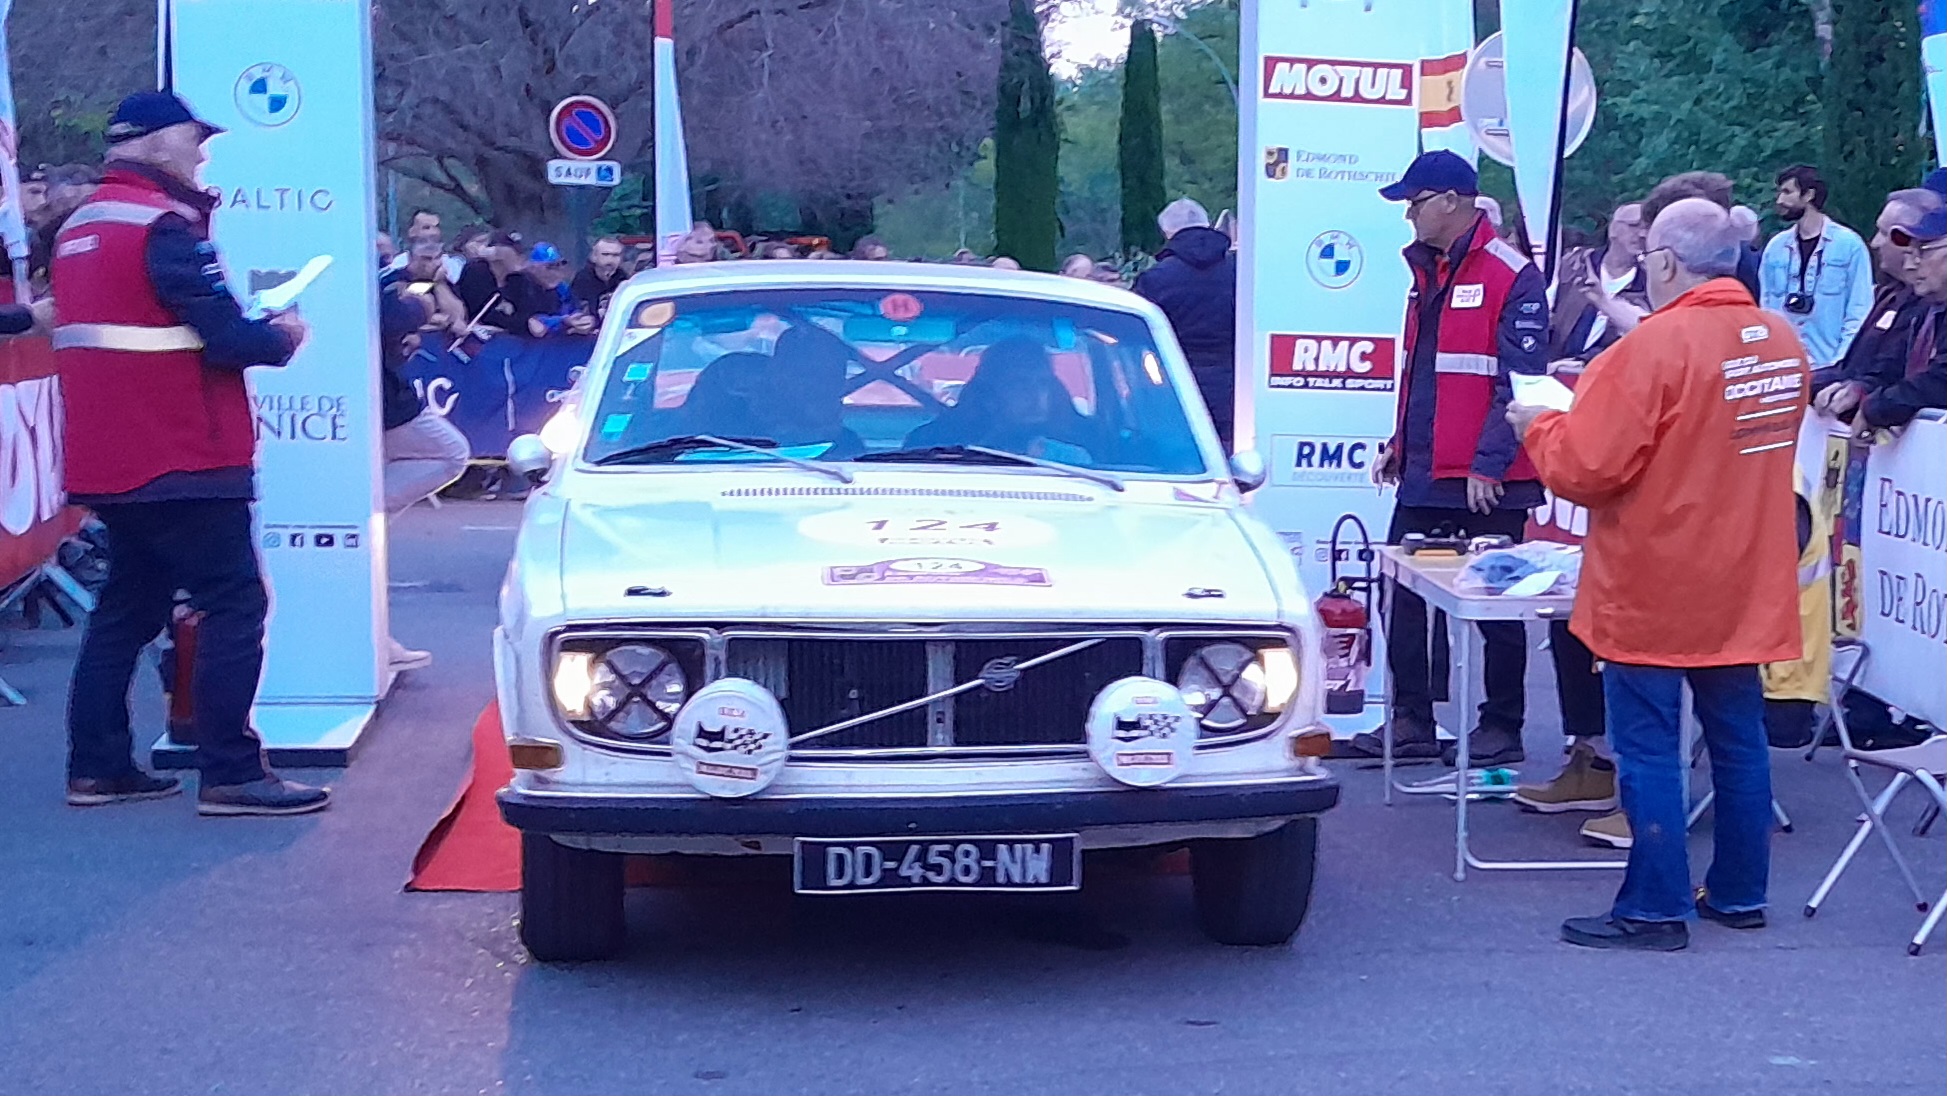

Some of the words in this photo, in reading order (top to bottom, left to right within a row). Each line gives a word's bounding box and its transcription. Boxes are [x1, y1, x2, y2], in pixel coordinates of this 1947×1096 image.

[1268, 62, 1408, 100] MOTUL
[1296, 168, 1315, 179] DE
[1318, 167, 1397, 182] ROTHSCHIL
[1292, 338, 1376, 373] RMC
[1270, 376, 1306, 387] INFO
[1307, 378, 1344, 388] TALK
[1345, 379, 1394, 390] SPORT
[253, 395, 313, 411] VILLE
[318, 395, 346, 412] DE
[256, 413, 347, 441] NICE
[1294, 441, 1368, 470] RMC
[866, 519, 1000, 531] 124
[1877, 477, 1947, 551] EDMO
[917, 562, 963, 570] 124
[1877, 569, 1907, 624] DE
[1911, 572, 1947, 645] RO
[826, 843, 1053, 886] DD-458-NW
